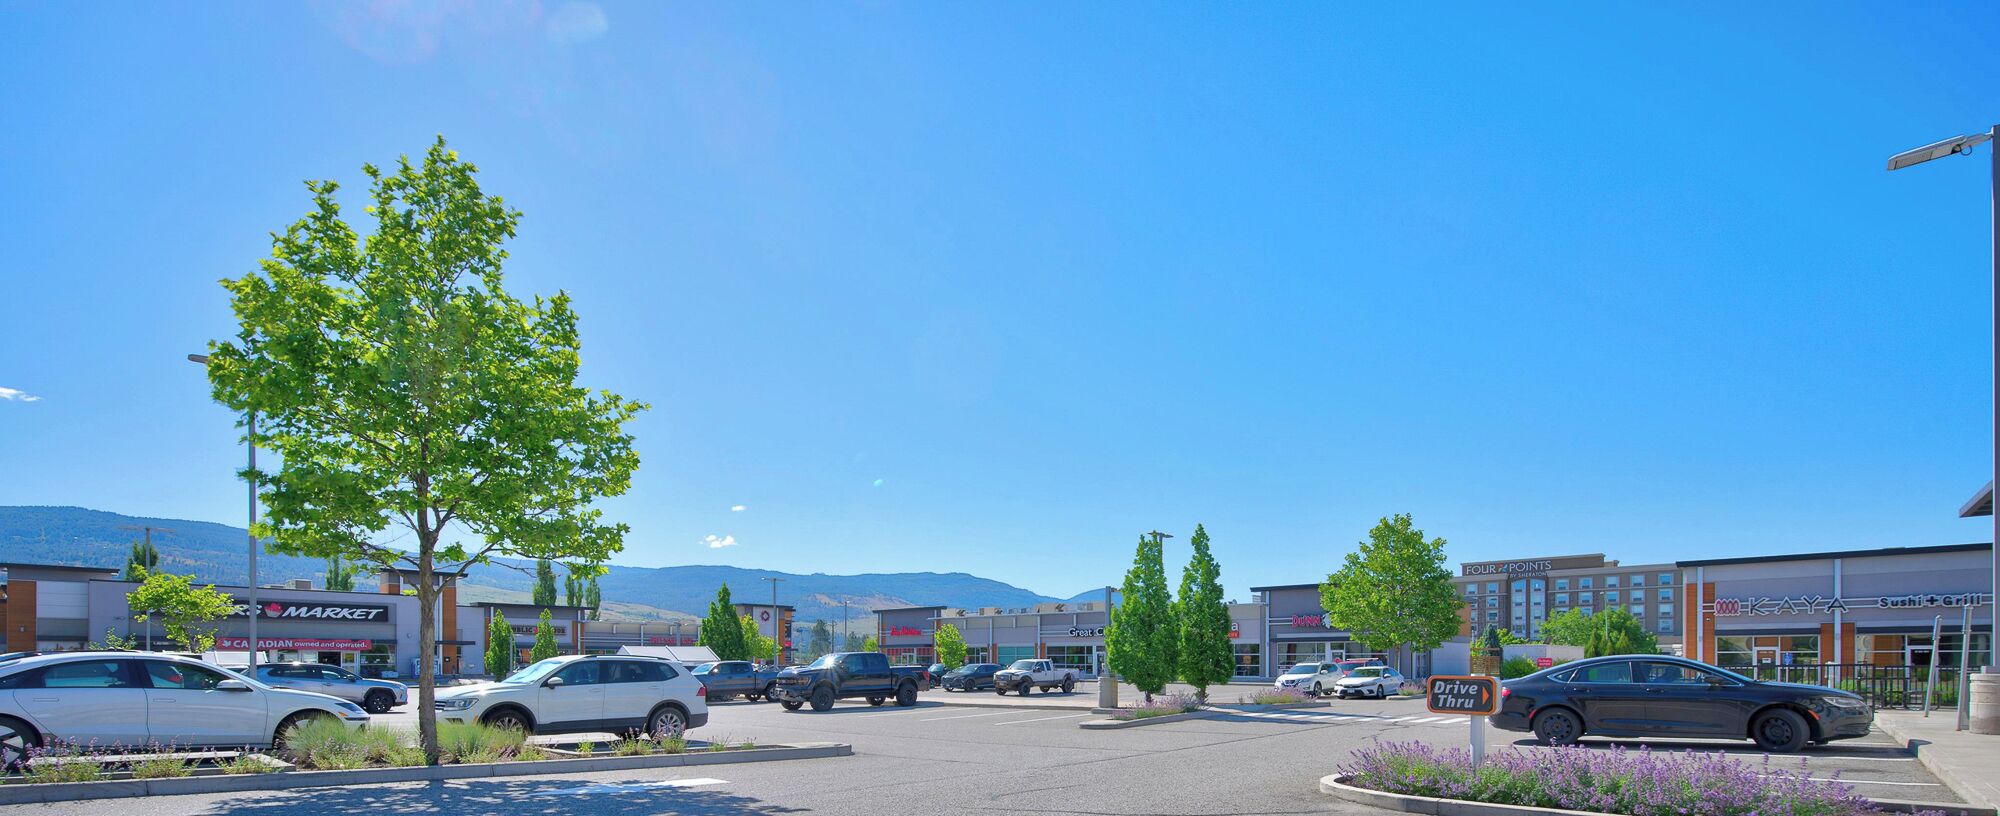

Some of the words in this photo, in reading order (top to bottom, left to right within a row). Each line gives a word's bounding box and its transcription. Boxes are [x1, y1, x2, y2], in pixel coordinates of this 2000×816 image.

[1466, 564, 1496, 575] FOUR
[1509, 560, 1552, 572] POINTS
[1748, 595, 1849, 616] KAYA
[282, 606, 384, 619] MARKET
[1068, 627, 1094, 637] Great
[233, 640, 293, 648] CAADIAN
[1434, 680, 1478, 694] Drive
[1438, 695, 1474, 708] Thru
